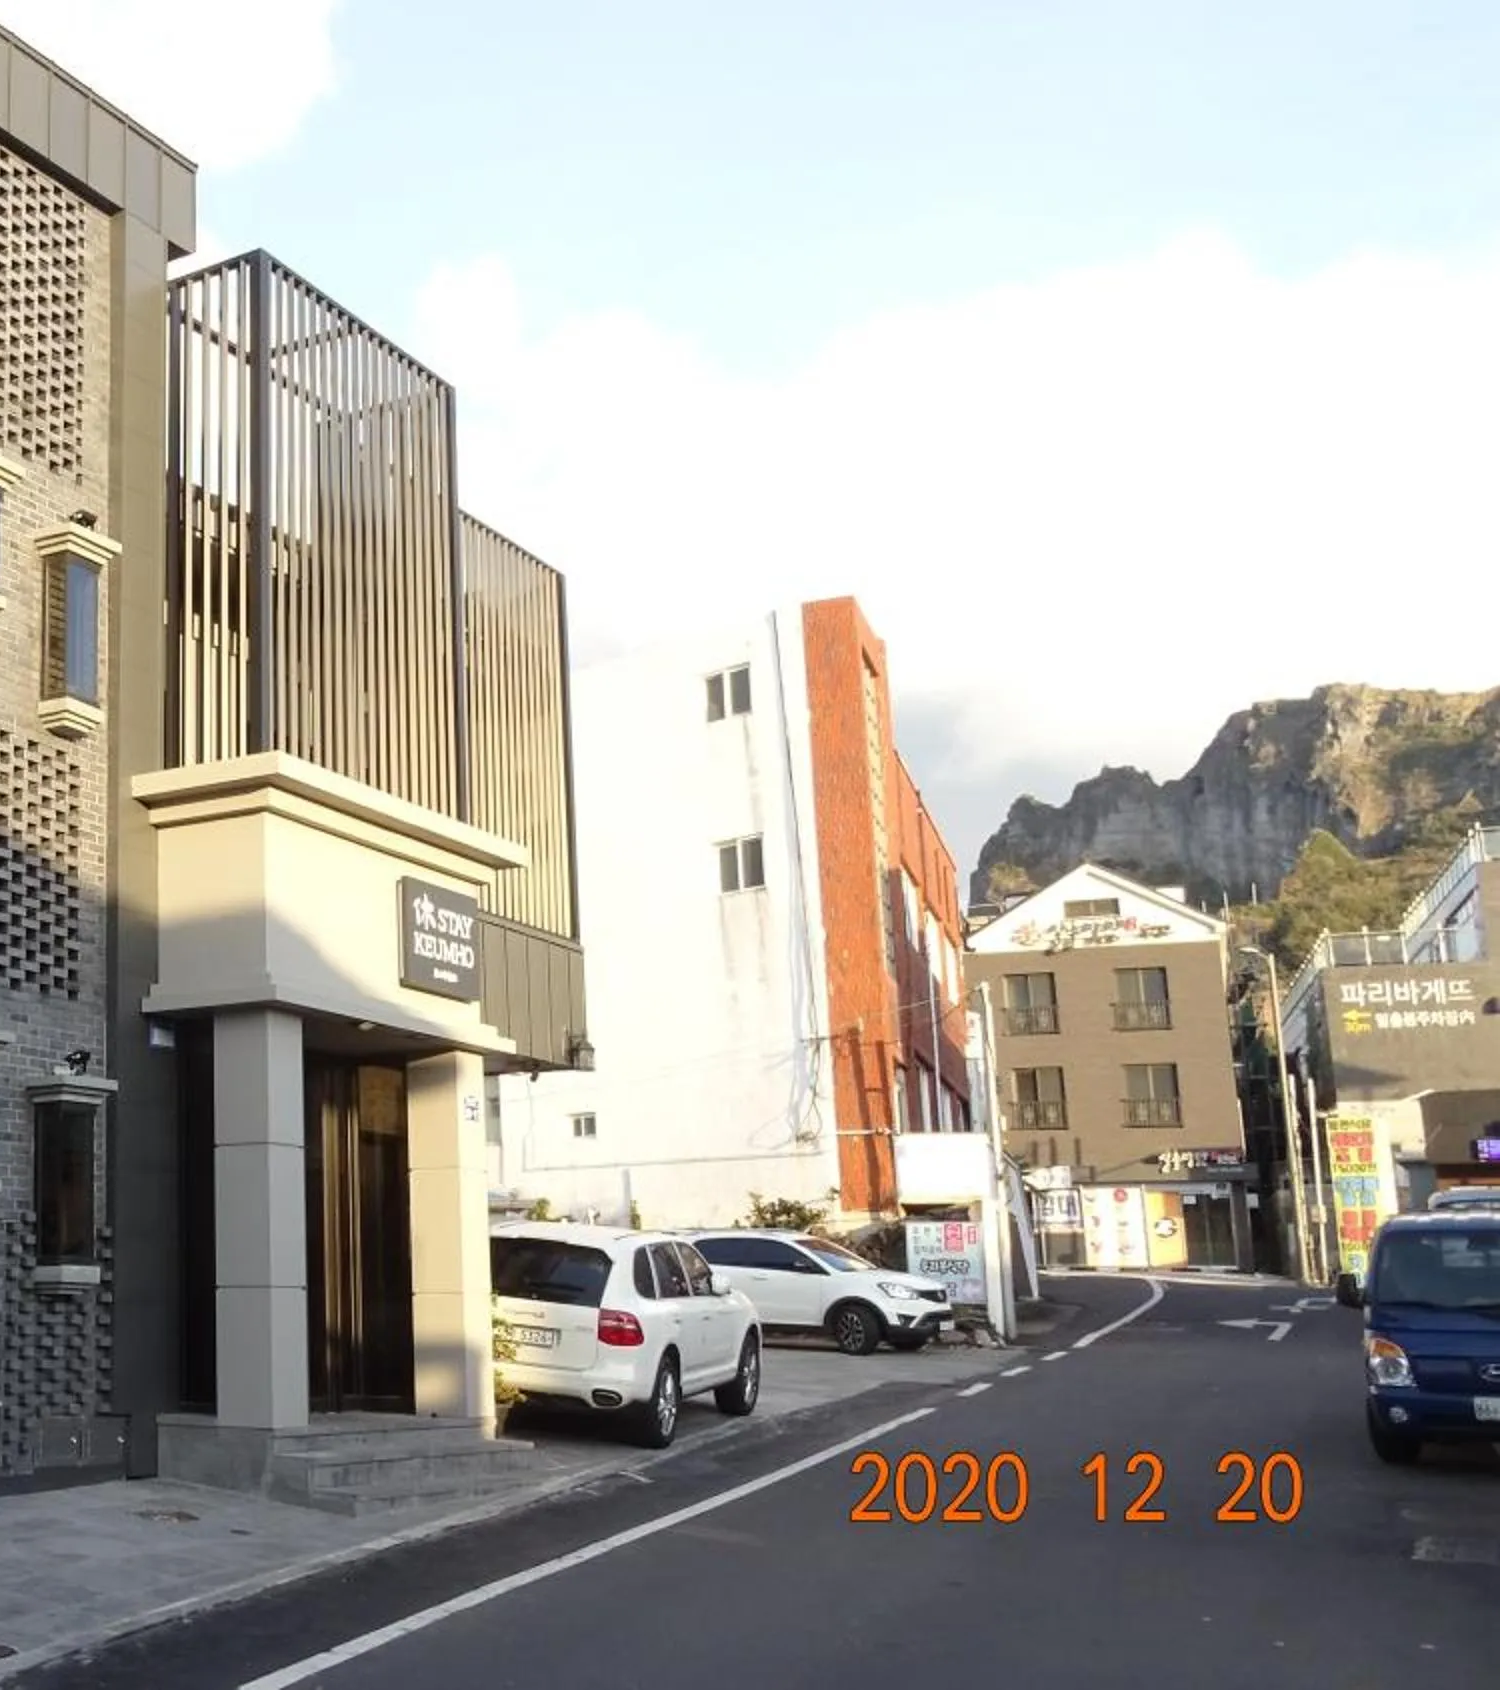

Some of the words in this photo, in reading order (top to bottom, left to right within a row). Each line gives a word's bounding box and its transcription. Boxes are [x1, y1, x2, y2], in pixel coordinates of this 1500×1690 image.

[437, 908, 474, 939] STAY
[413, 931, 475, 969] KEUMHO
[1340, 977, 1476, 1007] 파리바게뜨
